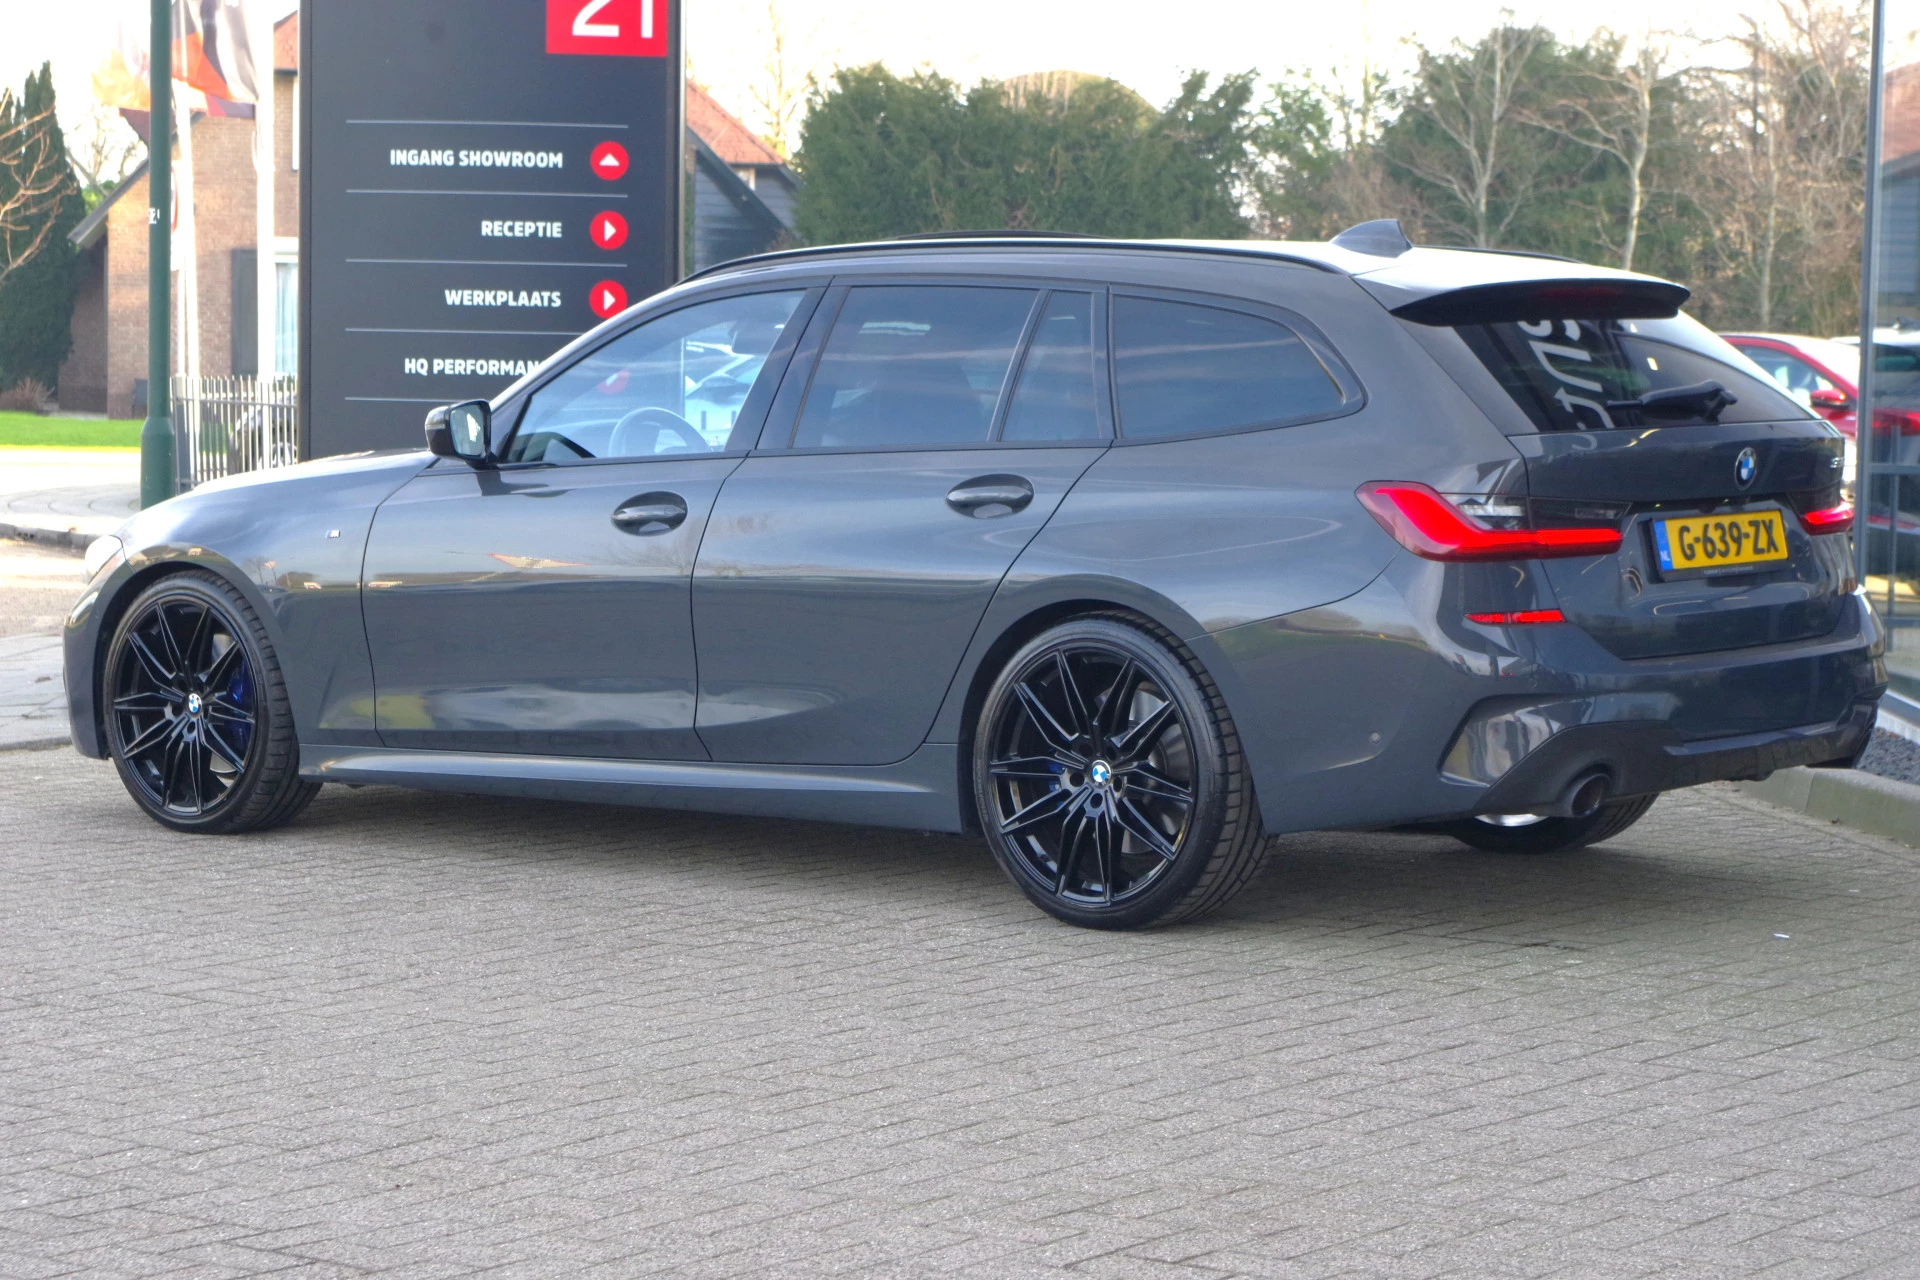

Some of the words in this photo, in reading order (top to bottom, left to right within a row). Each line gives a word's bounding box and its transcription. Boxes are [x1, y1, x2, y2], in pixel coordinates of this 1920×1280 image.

[390, 149, 454, 166] INGANG
[459, 150, 562, 168] SHOWROOM
[482, 221, 561, 237] RECEPTIE
[445, 290, 561, 307] WERKPLAATS
[405, 358, 428, 376] HQ
[433, 359, 543, 376] PERFORMAN
[1679, 519, 1779, 560] G-639-ZX
